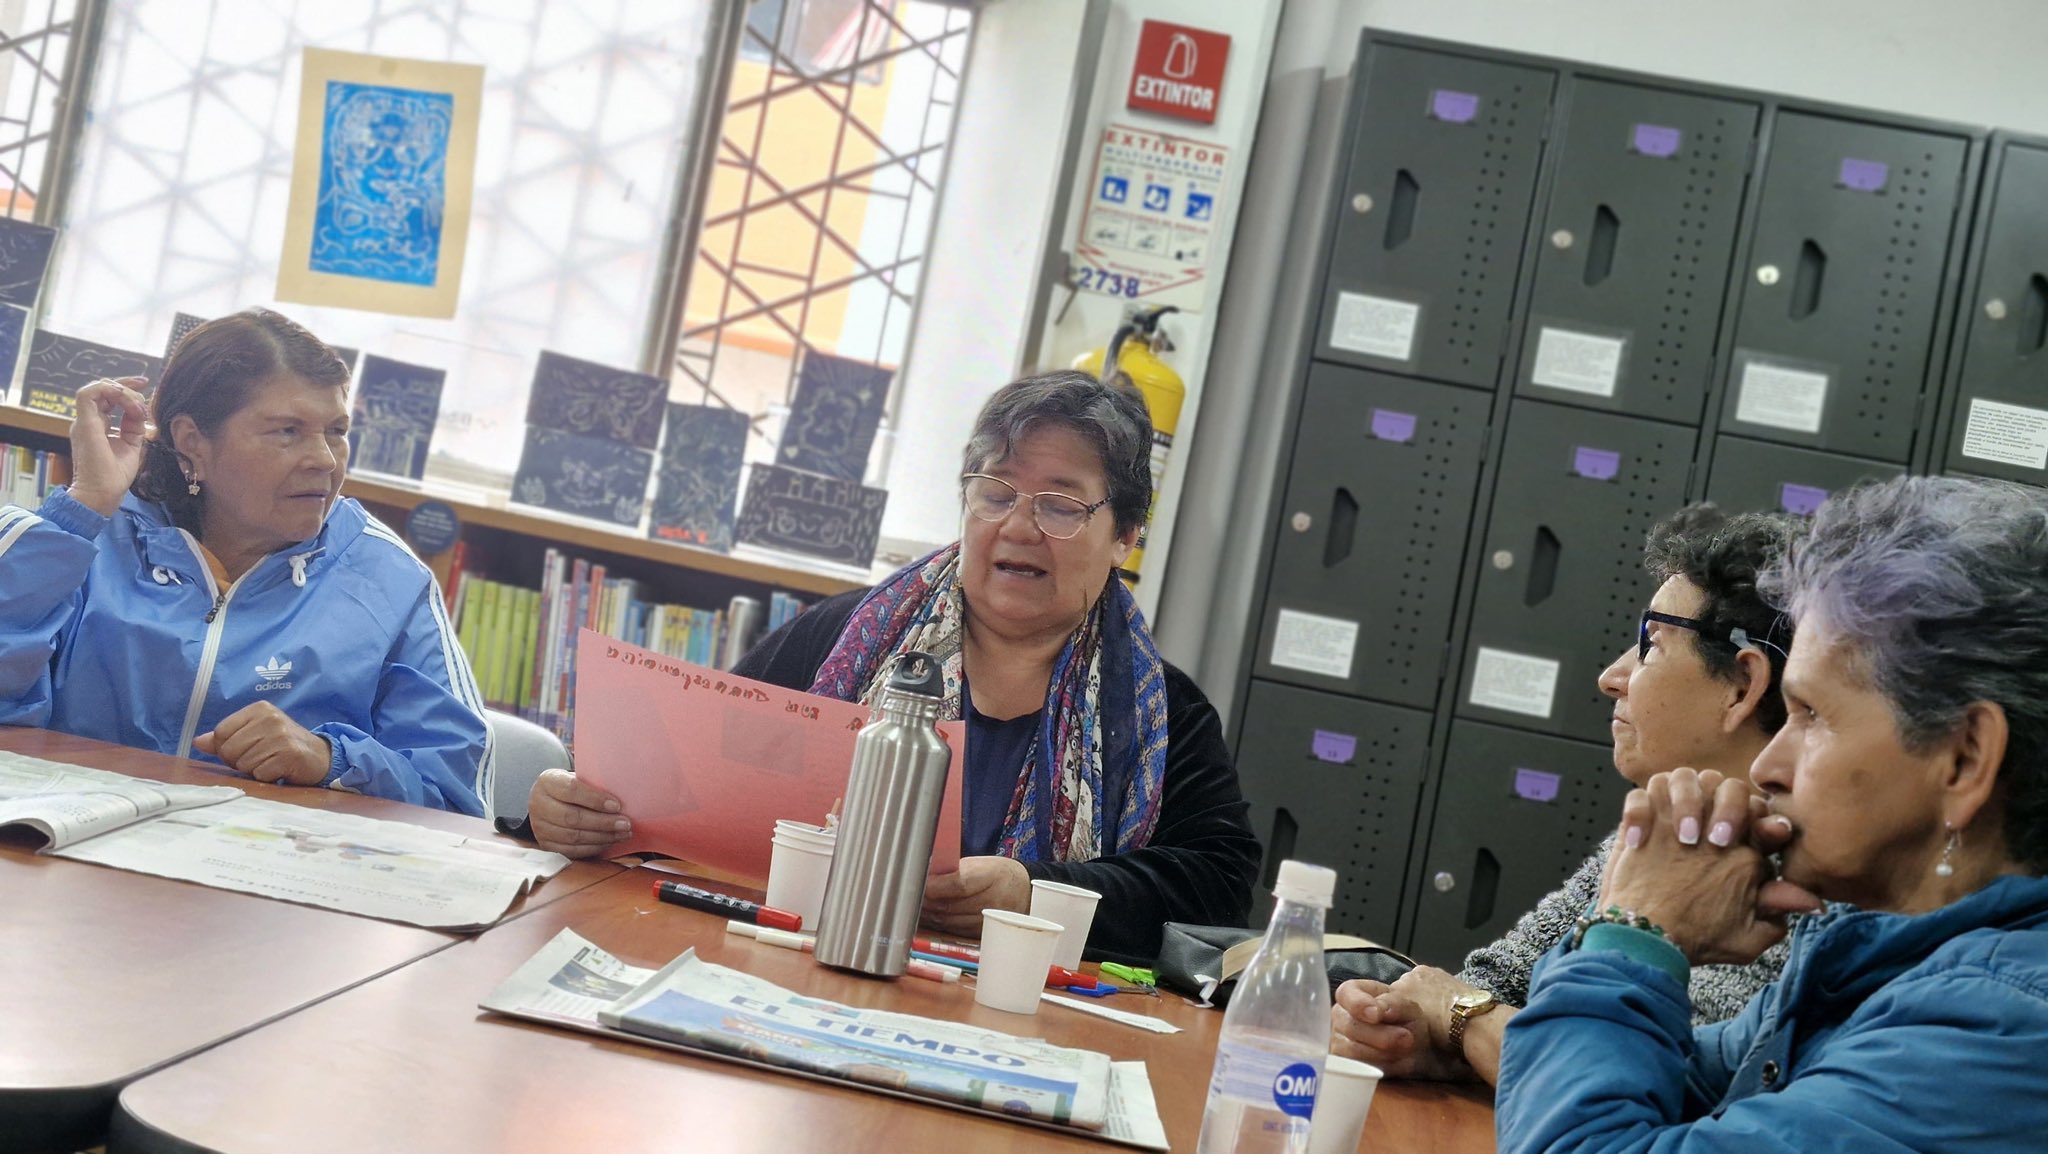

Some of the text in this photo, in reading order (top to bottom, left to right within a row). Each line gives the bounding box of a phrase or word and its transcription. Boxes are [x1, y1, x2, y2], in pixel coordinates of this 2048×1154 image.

[1135, 75, 1214, 111] EXTINTOR
[1105, 130, 1226, 165] EXTINTOR
[1078, 267, 1140, 298] 2738
[255, 681, 293, 692] adidas
[811, 1015, 1026, 1068] TIEMPO
